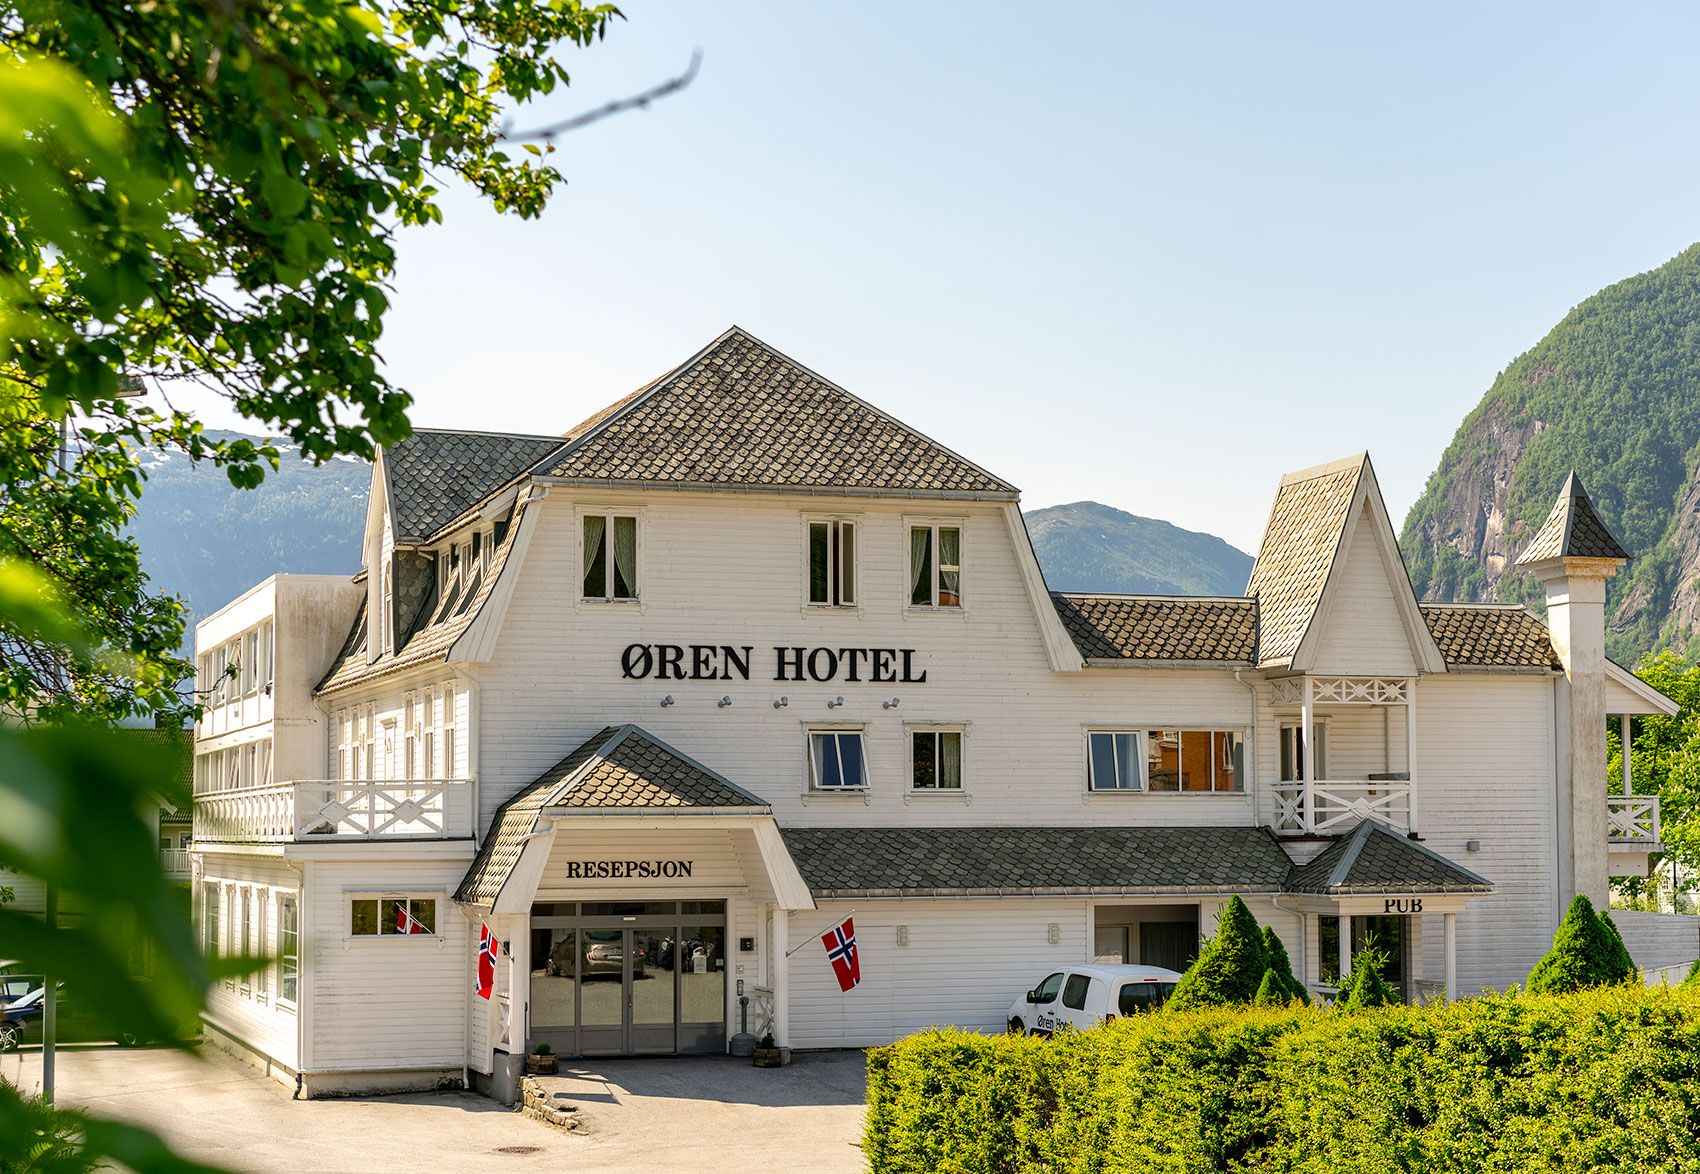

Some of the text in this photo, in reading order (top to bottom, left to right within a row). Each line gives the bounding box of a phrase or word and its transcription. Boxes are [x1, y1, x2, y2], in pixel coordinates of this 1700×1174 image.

[621, 643, 927, 683] ØREN HOTEL
[566, 860, 694, 879] RESEPSJON
[1384, 898, 1423, 913] PUB
[1037, 1014, 1054, 1030] Øren
